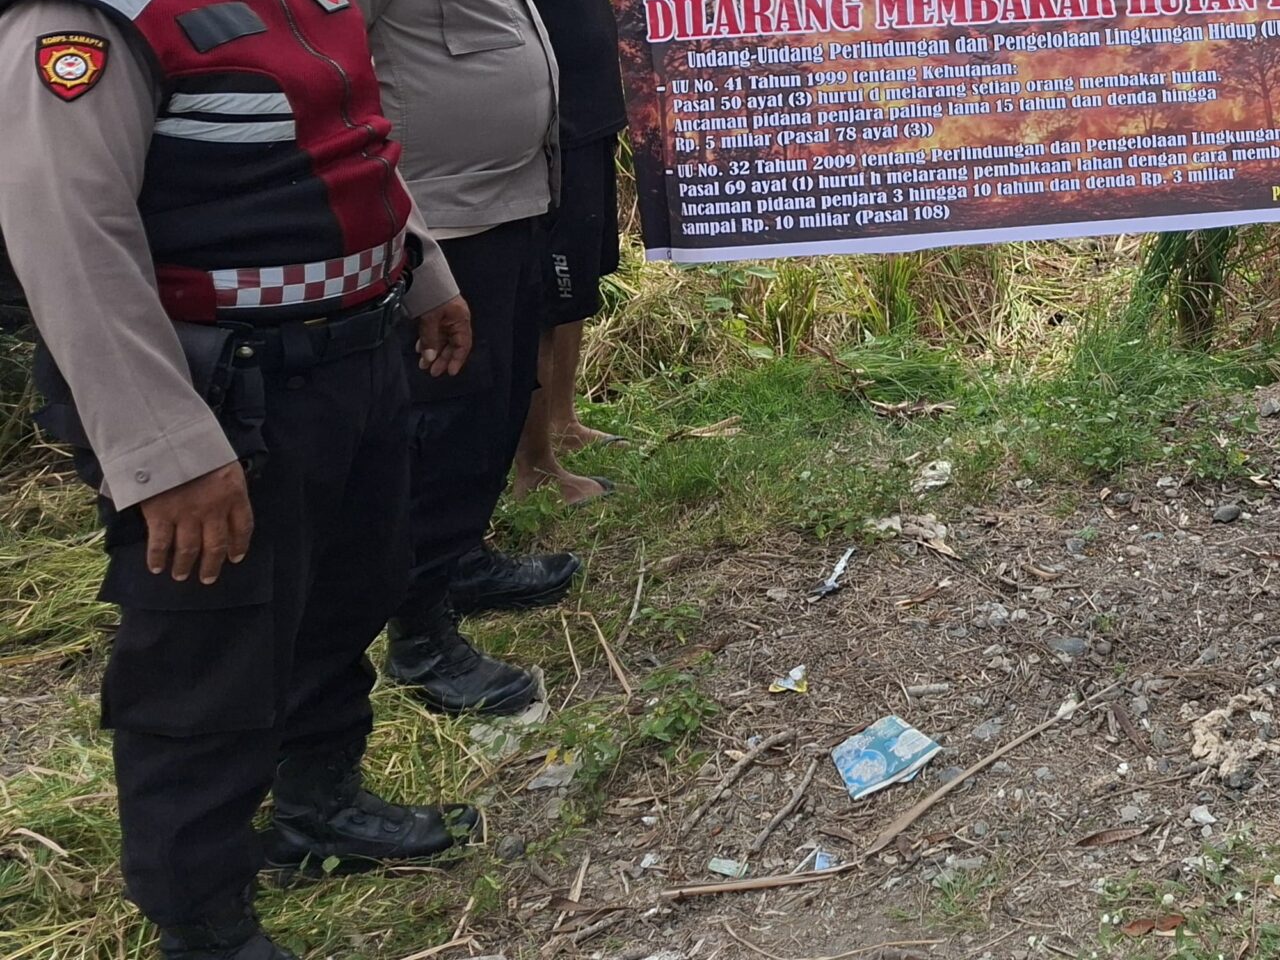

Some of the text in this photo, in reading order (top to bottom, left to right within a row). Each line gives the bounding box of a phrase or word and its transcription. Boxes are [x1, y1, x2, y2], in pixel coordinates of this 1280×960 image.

[69, 35, 103, 47] SAMAPTA
[687, 44, 823, 69] Undang-Undang
[829, 39, 949, 59] Perlindungan
[955, 36, 988, 53] dan
[993, 29, 1100, 52] Pengelolaan
[1105, 26, 1203, 47] Lingkungan
[1208, 23, 1256, 40] Hidup
[672, 80, 689, 94] UU
[694, 79, 718, 93] No.
[724, 77, 742, 91] 41
[749, 75, 801, 90] Tahun
[807, 71, 847, 86] 1999
[852, 66, 917, 83] tentang
[922, 63, 1018, 80] Kehutanan:
[673, 70, 1221, 113] Pasal 50 ayat (3) huruf d melarang setiap orang membakar hutan.
[674, 87, 1217, 133] Ancaman pidana penjara paling lama 15 tahun dan denda hingga
[675, 123, 934, 153] Rp. 5 miliar (Pasal 78 ayat (3))
[677, 164, 693, 179] UU
[698, 163, 723, 177] No.
[729, 161, 750, 175] 32
[755, 159, 807, 174] Tahun
[813, 155, 855, 170] 2009
[861, 149, 926, 167] tentang
[931, 143, 1044, 162] Perlindungan
[1050, 140, 1081, 155] dan
[1086, 133, 1187, 152] Pengelolaan
[679, 182, 719, 197] Pasal
[725, 180, 746, 195] 69
[751, 178, 787, 195] ayat
[792, 176, 813, 192] (1)
[819, 173, 864, 189] huruf
[871, 172, 881, 185] h
[887, 166, 968, 183] melarang
[973, 159, 1071, 180] pembukaan
[1077, 156, 1123, 172] lahan
[1128, 152, 1187, 169] dengan
[1193, 148, 1227, 164] cara
[681, 167, 1235, 216] Ancaman pidana penjara 3 hingga 10 tahun dan denda Rp. 3 miliar
[682, 205, 949, 236] sampai Rp. 10 miliar (Pasal 108)
[552, 253, 573, 298] RUSH
